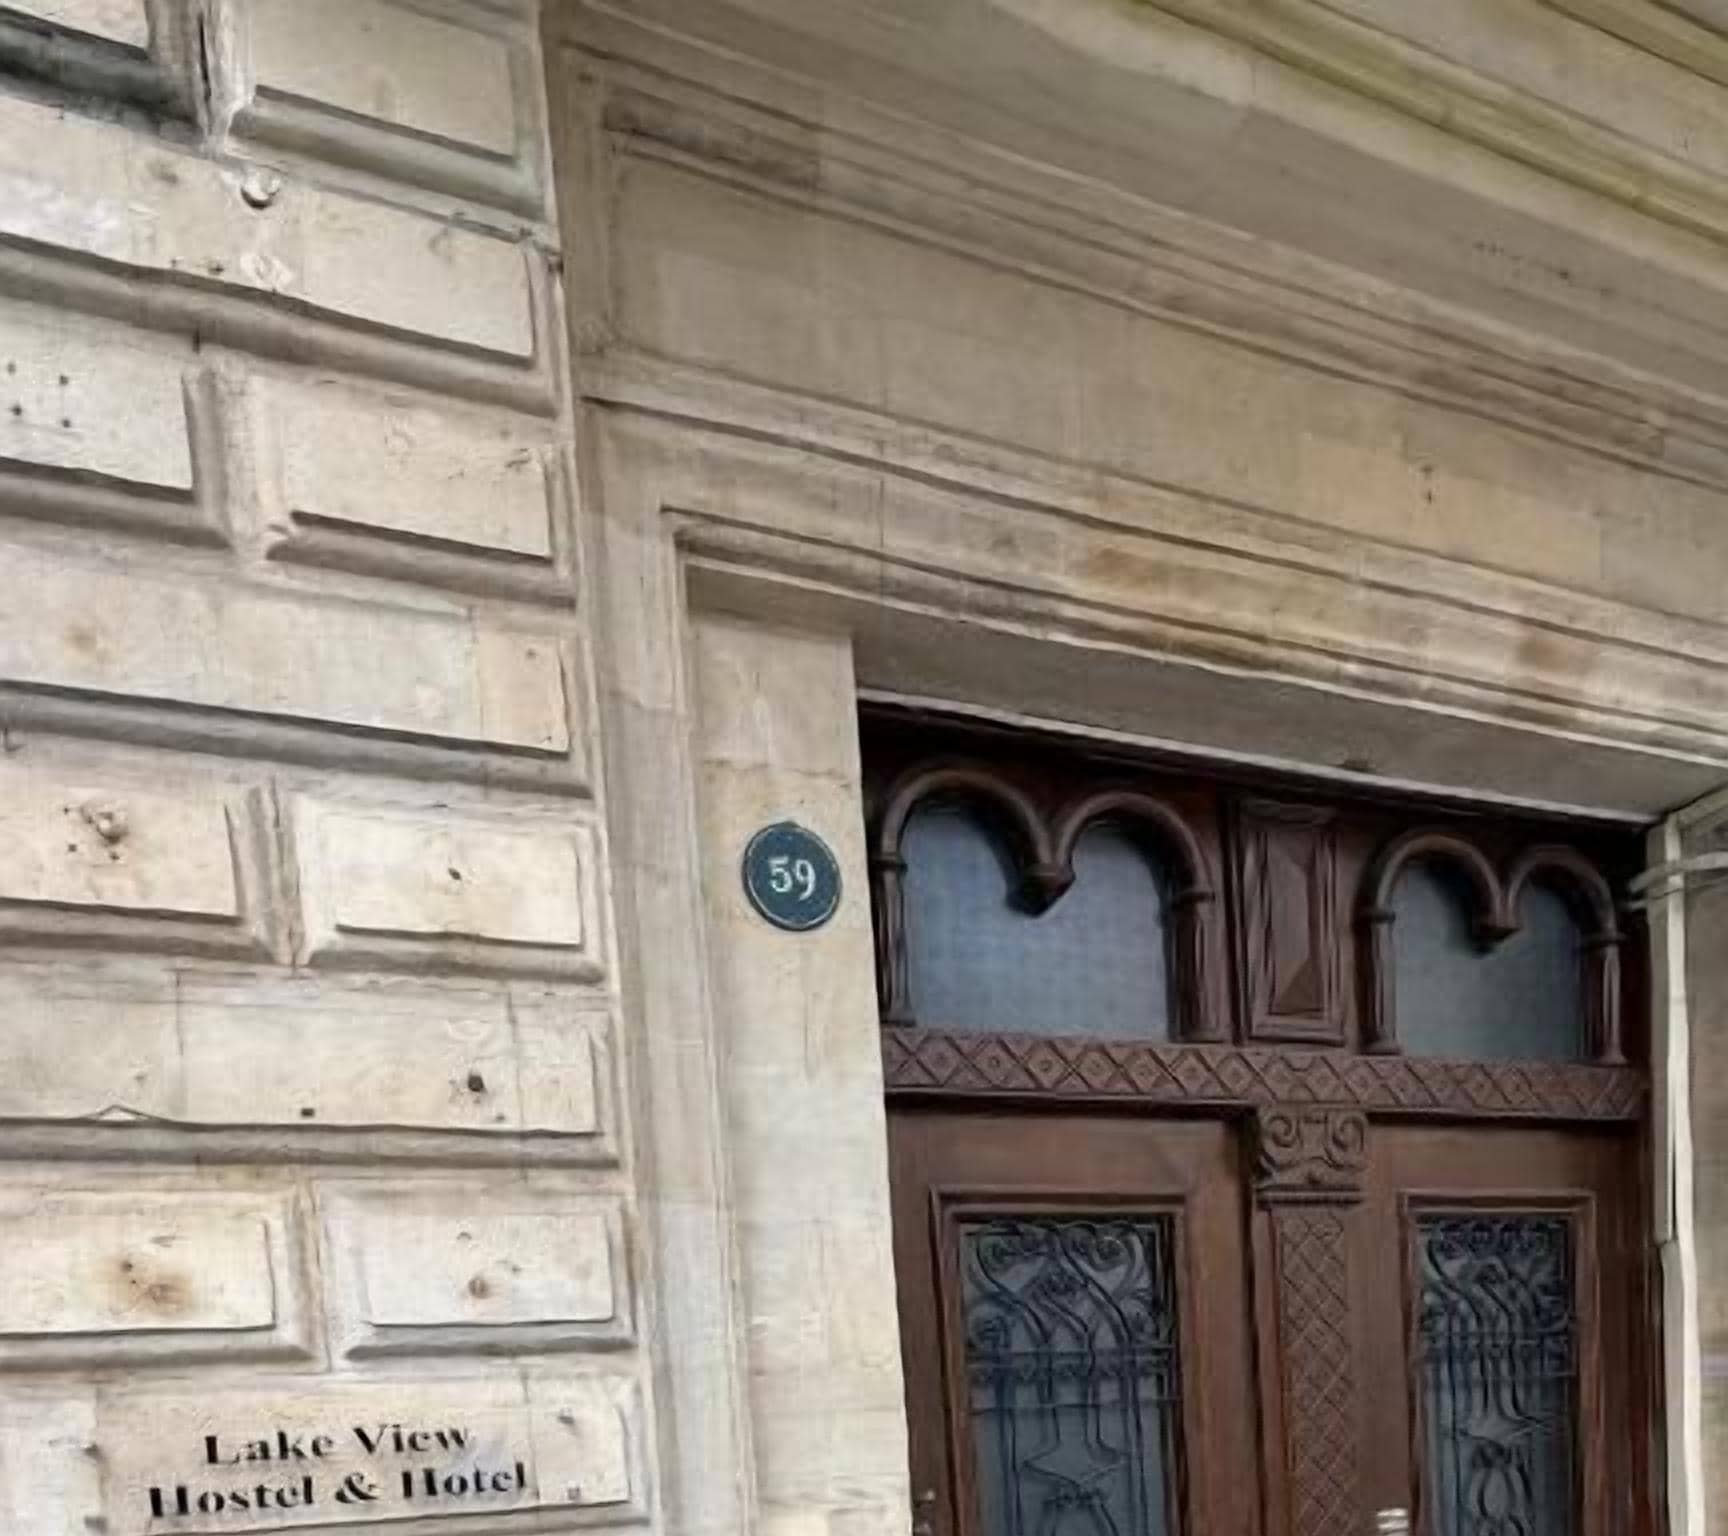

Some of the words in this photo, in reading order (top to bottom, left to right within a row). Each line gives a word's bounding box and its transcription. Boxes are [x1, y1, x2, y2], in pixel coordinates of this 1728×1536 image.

[768, 855, 816, 901] 59
[205, 1429, 335, 1465] Lake
[353, 1423, 471, 1455] View
[148, 1475, 314, 1517] Hostel
[335, 1471, 380, 1504] &
[401, 1461, 526, 1499] Hotel
